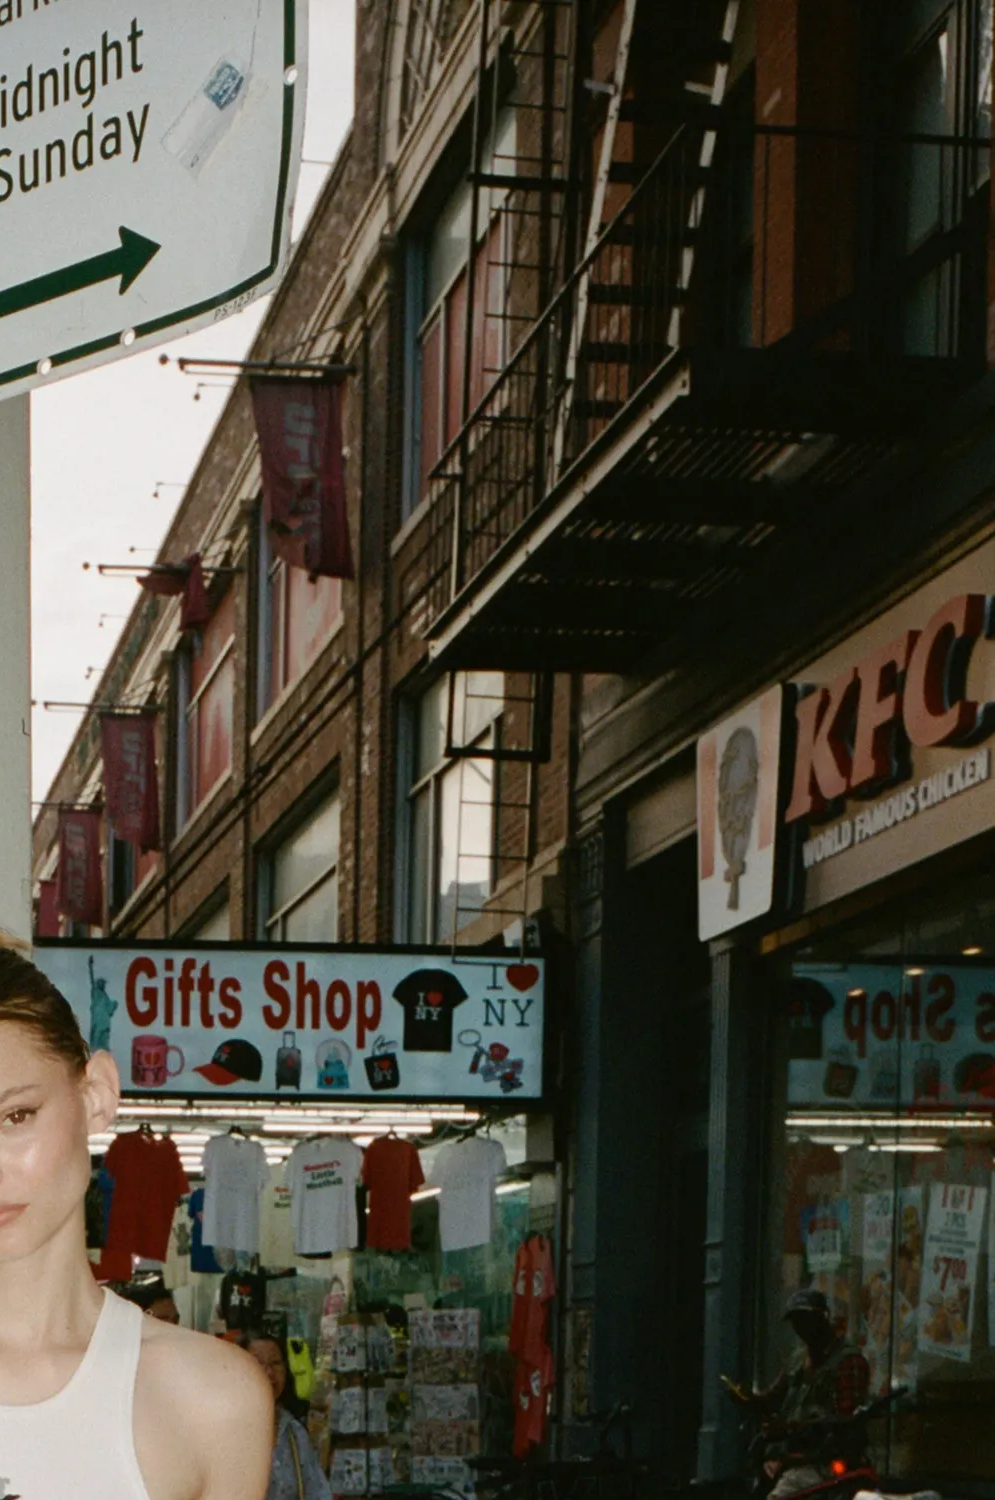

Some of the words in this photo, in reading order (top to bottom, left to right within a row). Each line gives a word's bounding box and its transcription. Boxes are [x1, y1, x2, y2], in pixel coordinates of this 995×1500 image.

[785, 594, 978, 823] KFC
[802, 819, 855, 870] WORLD
[853, 786, 917, 845] FAMOUS
[916, 747, 991, 813] CHICKEN
[126, 956, 242, 1029] Gifts
[262, 959, 382, 1050] Shop
[486, 964, 504, 990] I
[414, 1006, 443, 1021] NY
[482, 998, 534, 1027] NY
